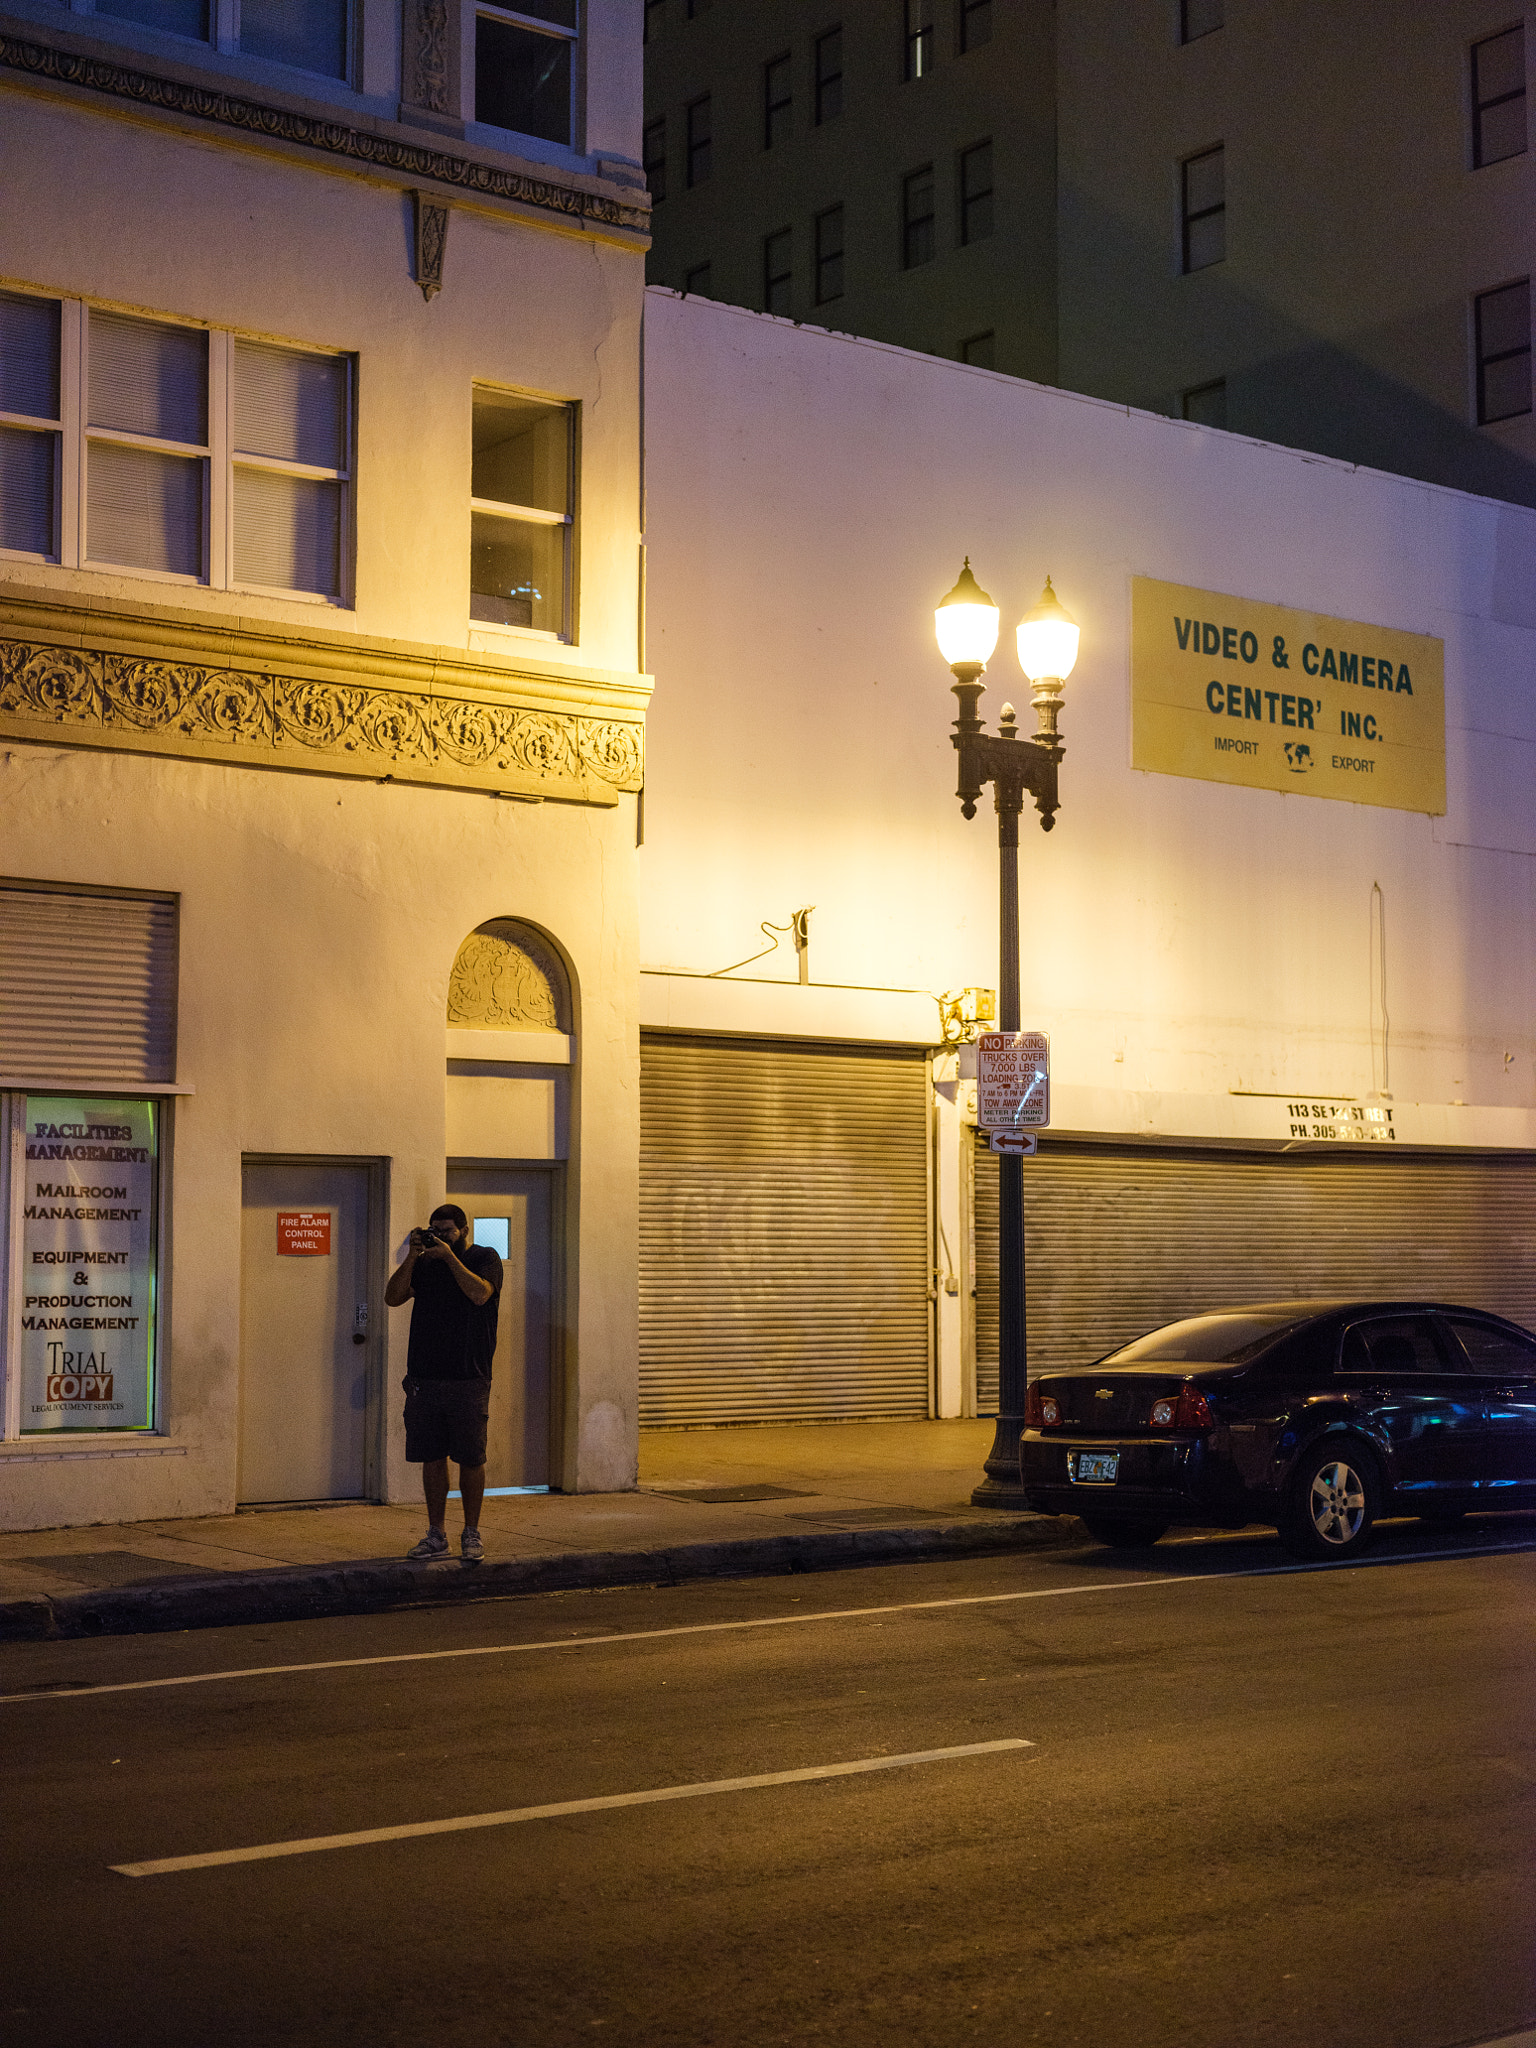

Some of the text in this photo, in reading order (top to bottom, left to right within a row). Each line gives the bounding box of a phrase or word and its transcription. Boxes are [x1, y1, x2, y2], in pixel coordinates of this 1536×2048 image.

[1173, 616, 1413, 696] VIDEO & CAMERA
[1341, 711, 1383, 742] INC.
[1214, 736, 1259, 756] IMPORT
[1331, 755, 1375, 773] EXPORT
[984, 1038, 1001, 1049] NO
[982, 1053, 1045, 1061] TRUCKS OVER
[990, 1063, 1036, 1073] 7,000 LBS
[982, 1074, 1045, 1083] LOADING ZO
[984, 1098, 1043, 1107] TOW AWAY ZONE
[1287, 1104, 1309, 1118] 113
[1312, 1105, 1328, 1118] SE
[35, 1123, 133, 1141] FACILITIES
[1290, 1124, 1311, 1137] PH.
[26, 1144, 150, 1163] MANAGEMENT
[36, 1183, 127, 1199] MAILROOM
[23, 1205, 141, 1220] MANAGEMENT
[280, 1218, 329, 1226] FIRE ALARM
[285, 1229, 325, 1238] CONTROL
[291, 1241, 318, 1249] PANEL
[32, 1251, 129, 1265] EQUIPMENT
[73, 1271, 88, 1286] &
[25, 1295, 132, 1308] PRODUCTION
[22, 1316, 139, 1330] MANAGEMENT
[47, 1342, 113, 1375] TRIAL
[49, 1375, 112, 1400] COPY
[31, 1404, 53, 1413] LEGAL
[94, 1402, 124, 1411] SERVICES
